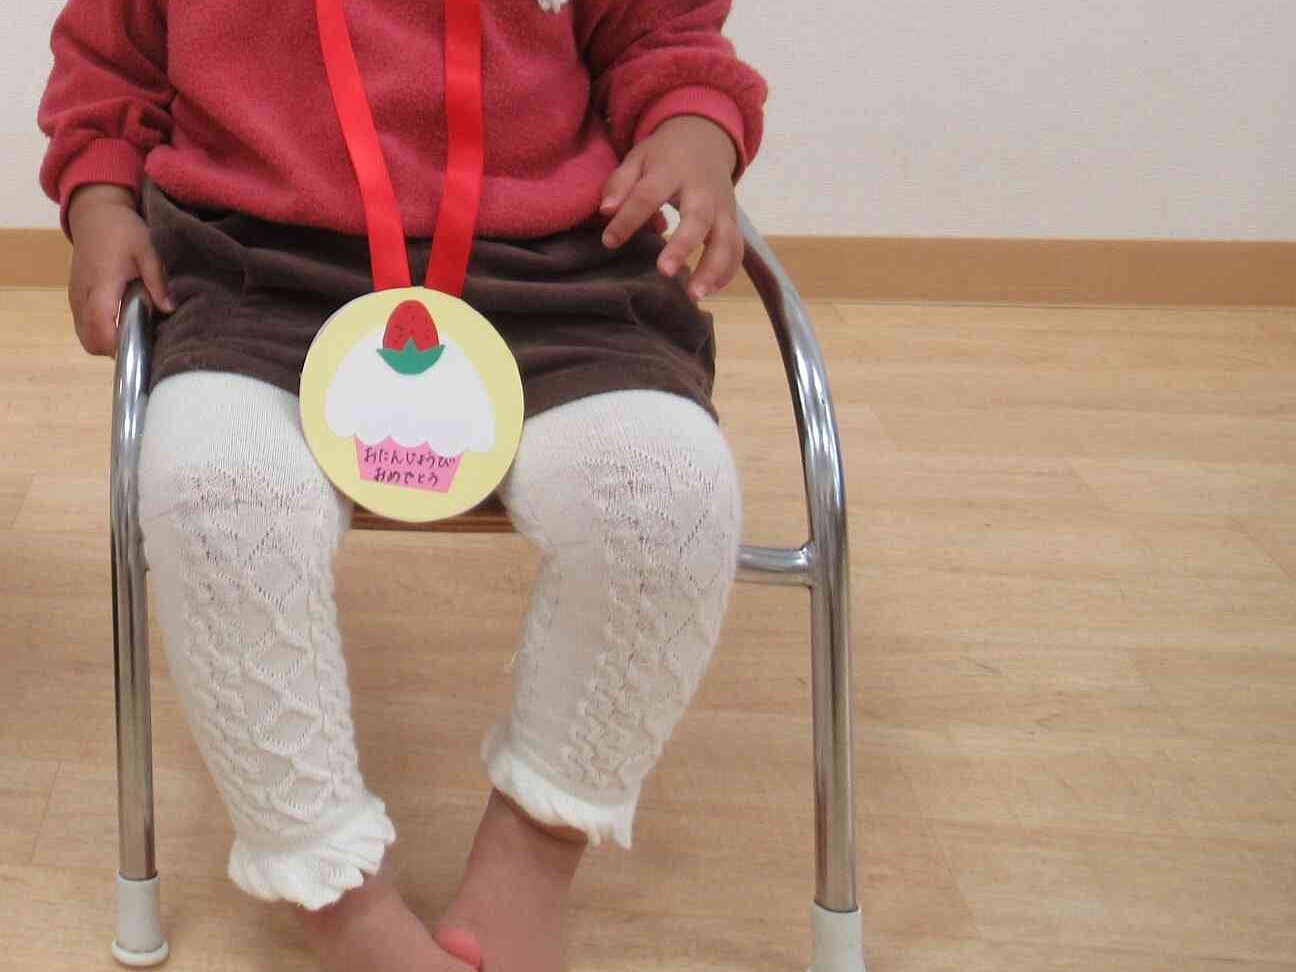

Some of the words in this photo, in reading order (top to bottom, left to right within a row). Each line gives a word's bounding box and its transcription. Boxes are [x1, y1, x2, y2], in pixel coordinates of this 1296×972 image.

[364, 446, 455, 469] おたんじょうび
[374, 467, 439, 487] おめでとう
